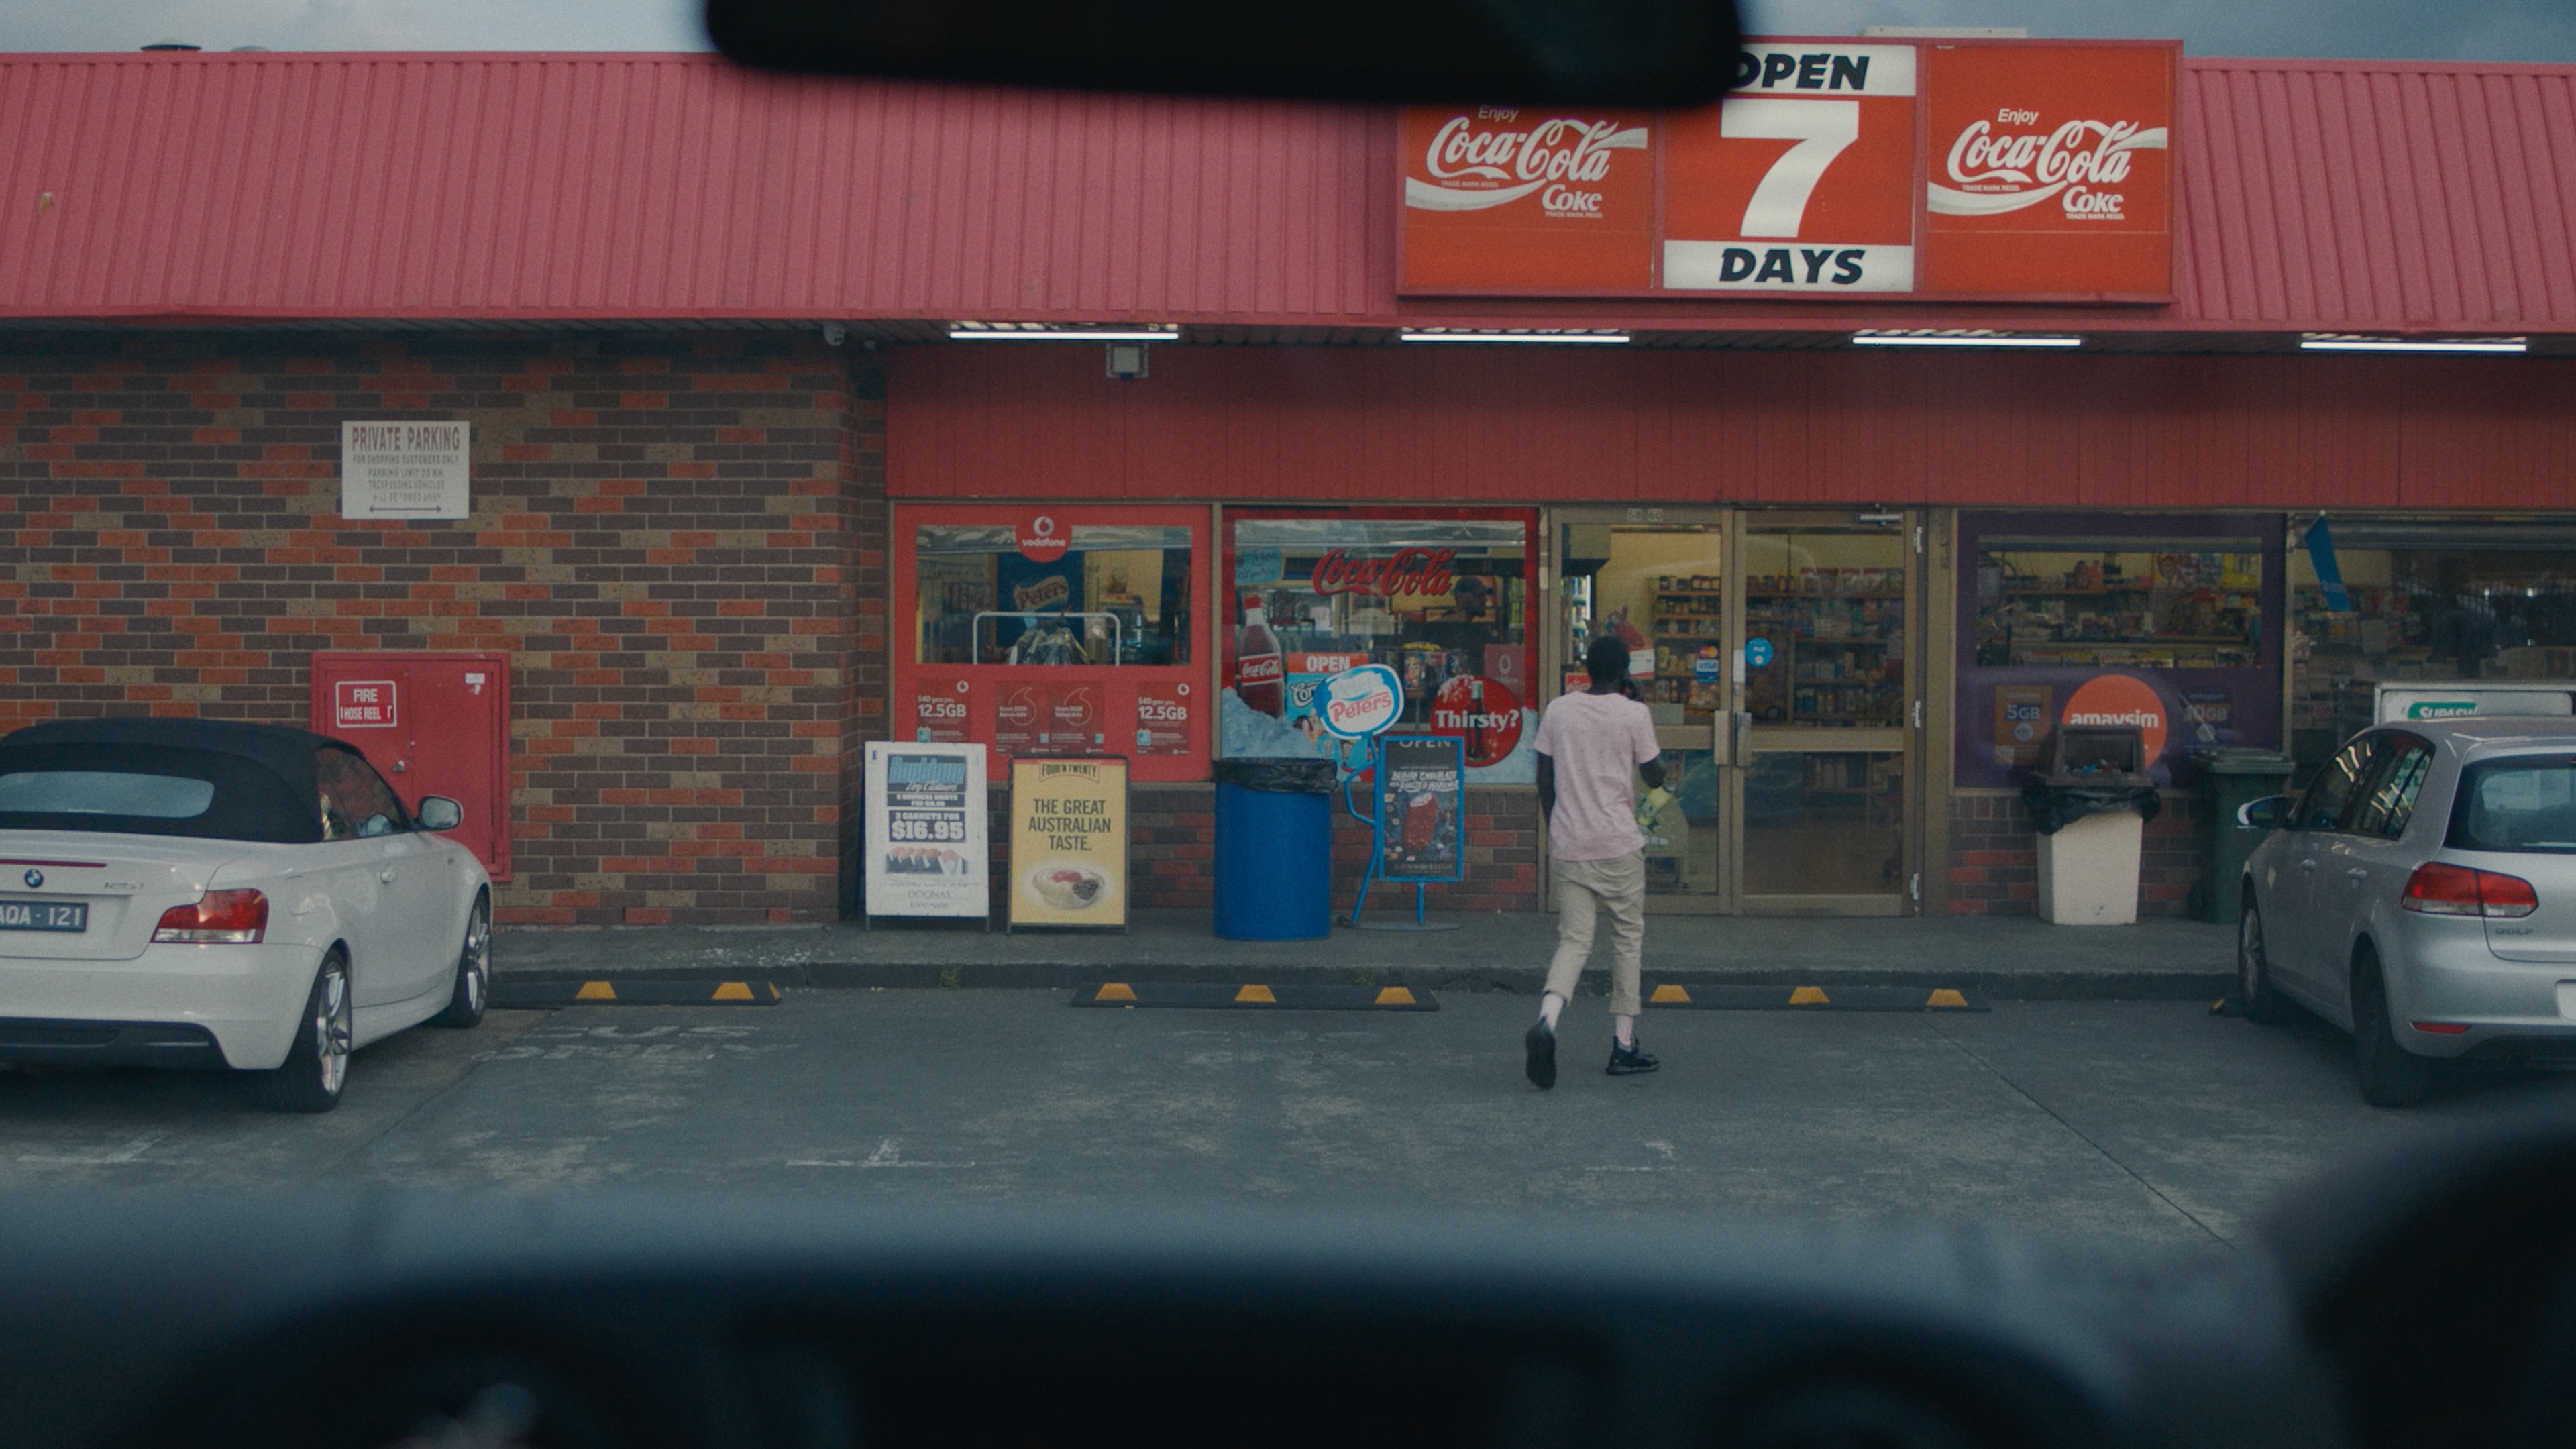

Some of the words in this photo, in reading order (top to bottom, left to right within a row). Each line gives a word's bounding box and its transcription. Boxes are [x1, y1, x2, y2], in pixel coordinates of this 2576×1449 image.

[1477, 105, 1519, 123] Enjoy
[1997, 108, 2039, 126] Enjoy
[1426, 117, 1612, 182] Coca-Cola
[1947, 119, 2133, 184] Coca-Cola
[1721, 98, 1859, 238] 7
[1542, 184, 1603, 212] Coke
[2062, 186, 2125, 213] Coke
[1719, 248, 1866, 284] DAYS
[352, 427, 401, 451] PRIVATE
[407, 427, 460, 451] PARKING
[353, 454, 366, 464] FOR
[368, 454, 400, 464] SHOPPING
[402, 454, 440, 464] CUSTOMERS
[442, 454, 459, 464] ONLY
[1022, 537, 1066, 548] vodafone
[1311, 547, 1458, 597] Coca-Cola
[1016, 581, 1068, 609] Peters
[1305, 655, 1350, 672] OPEN
[353, 688, 378, 702] FIRE
[343, 707, 363, 720] HOSE
[363, 706, 382, 720] REEL
[918, 704, 967, 718] 12.5GB
[1138, 706, 1187, 720] 12.5GB
[1329, 690, 1392, 724] Peters
[2006, 704, 2041, 720] 5GB
[1434, 709, 1519, 732] Thirsty?
[1069, 763, 1097, 777] TWENTY
[1033, 798, 1059, 814] THE
[1063, 799, 1106, 815] GREAT
[943, 812, 960, 820] FOR
[1028, 816, 1111, 833] AUSTRALIAN
[892, 820, 964, 841] $16.95
[1048, 835, 1092, 851] TASTE.
[2494, 928, 2534, 936] GOLF
